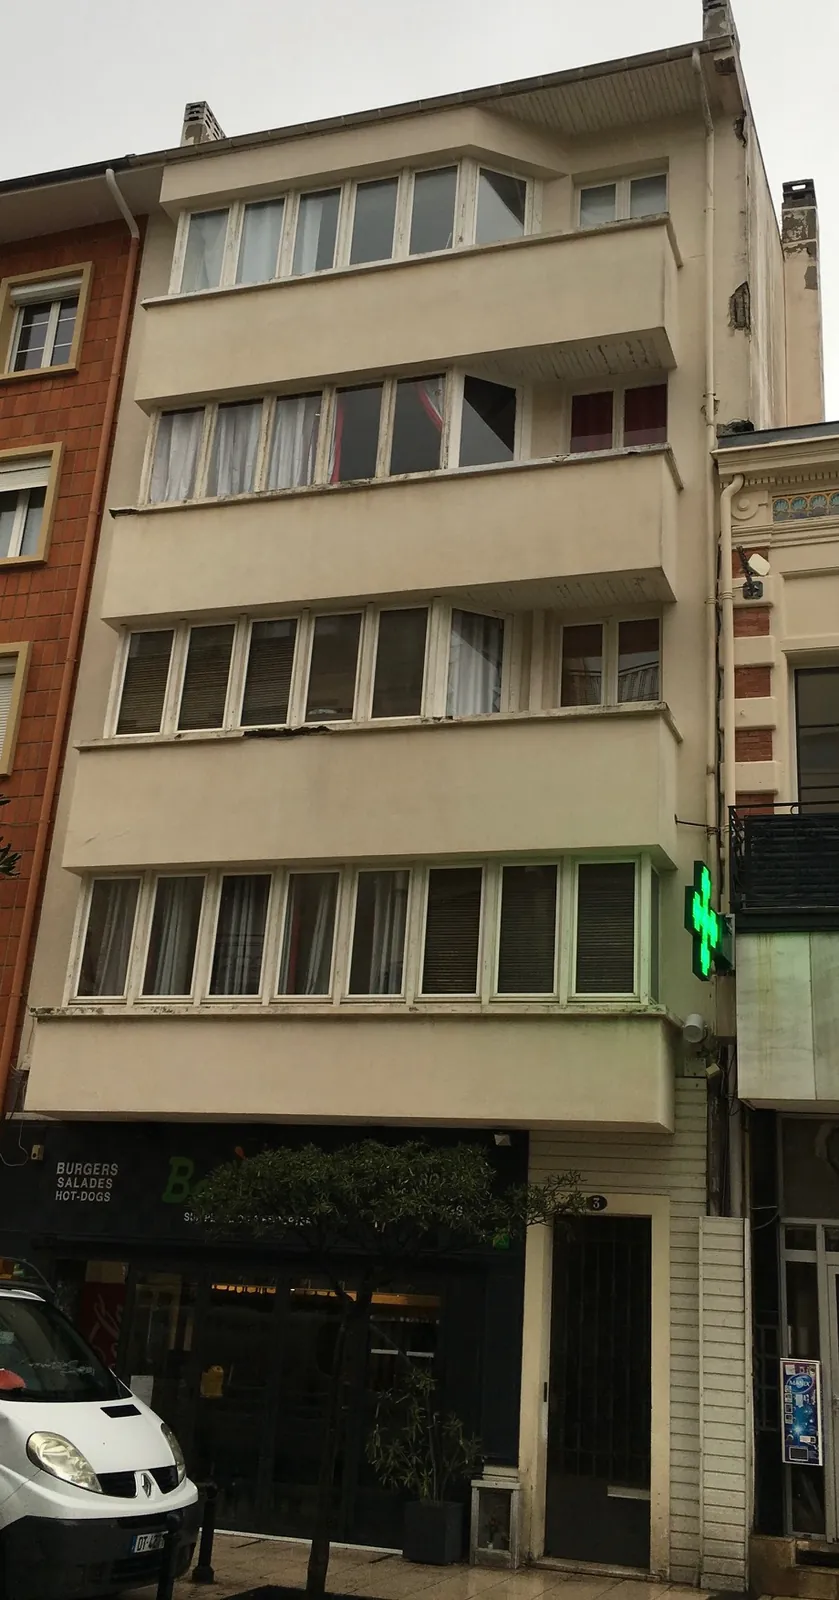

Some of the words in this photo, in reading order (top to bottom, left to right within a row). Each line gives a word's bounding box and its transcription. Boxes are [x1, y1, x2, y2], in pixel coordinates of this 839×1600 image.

[56, 1162, 119, 1176] BURGERS
[56, 1176, 113, 1189] SALADES
[55, 1190, 111, 1202] HOT-DOGS
[592, 1197, 601, 1209] 3
